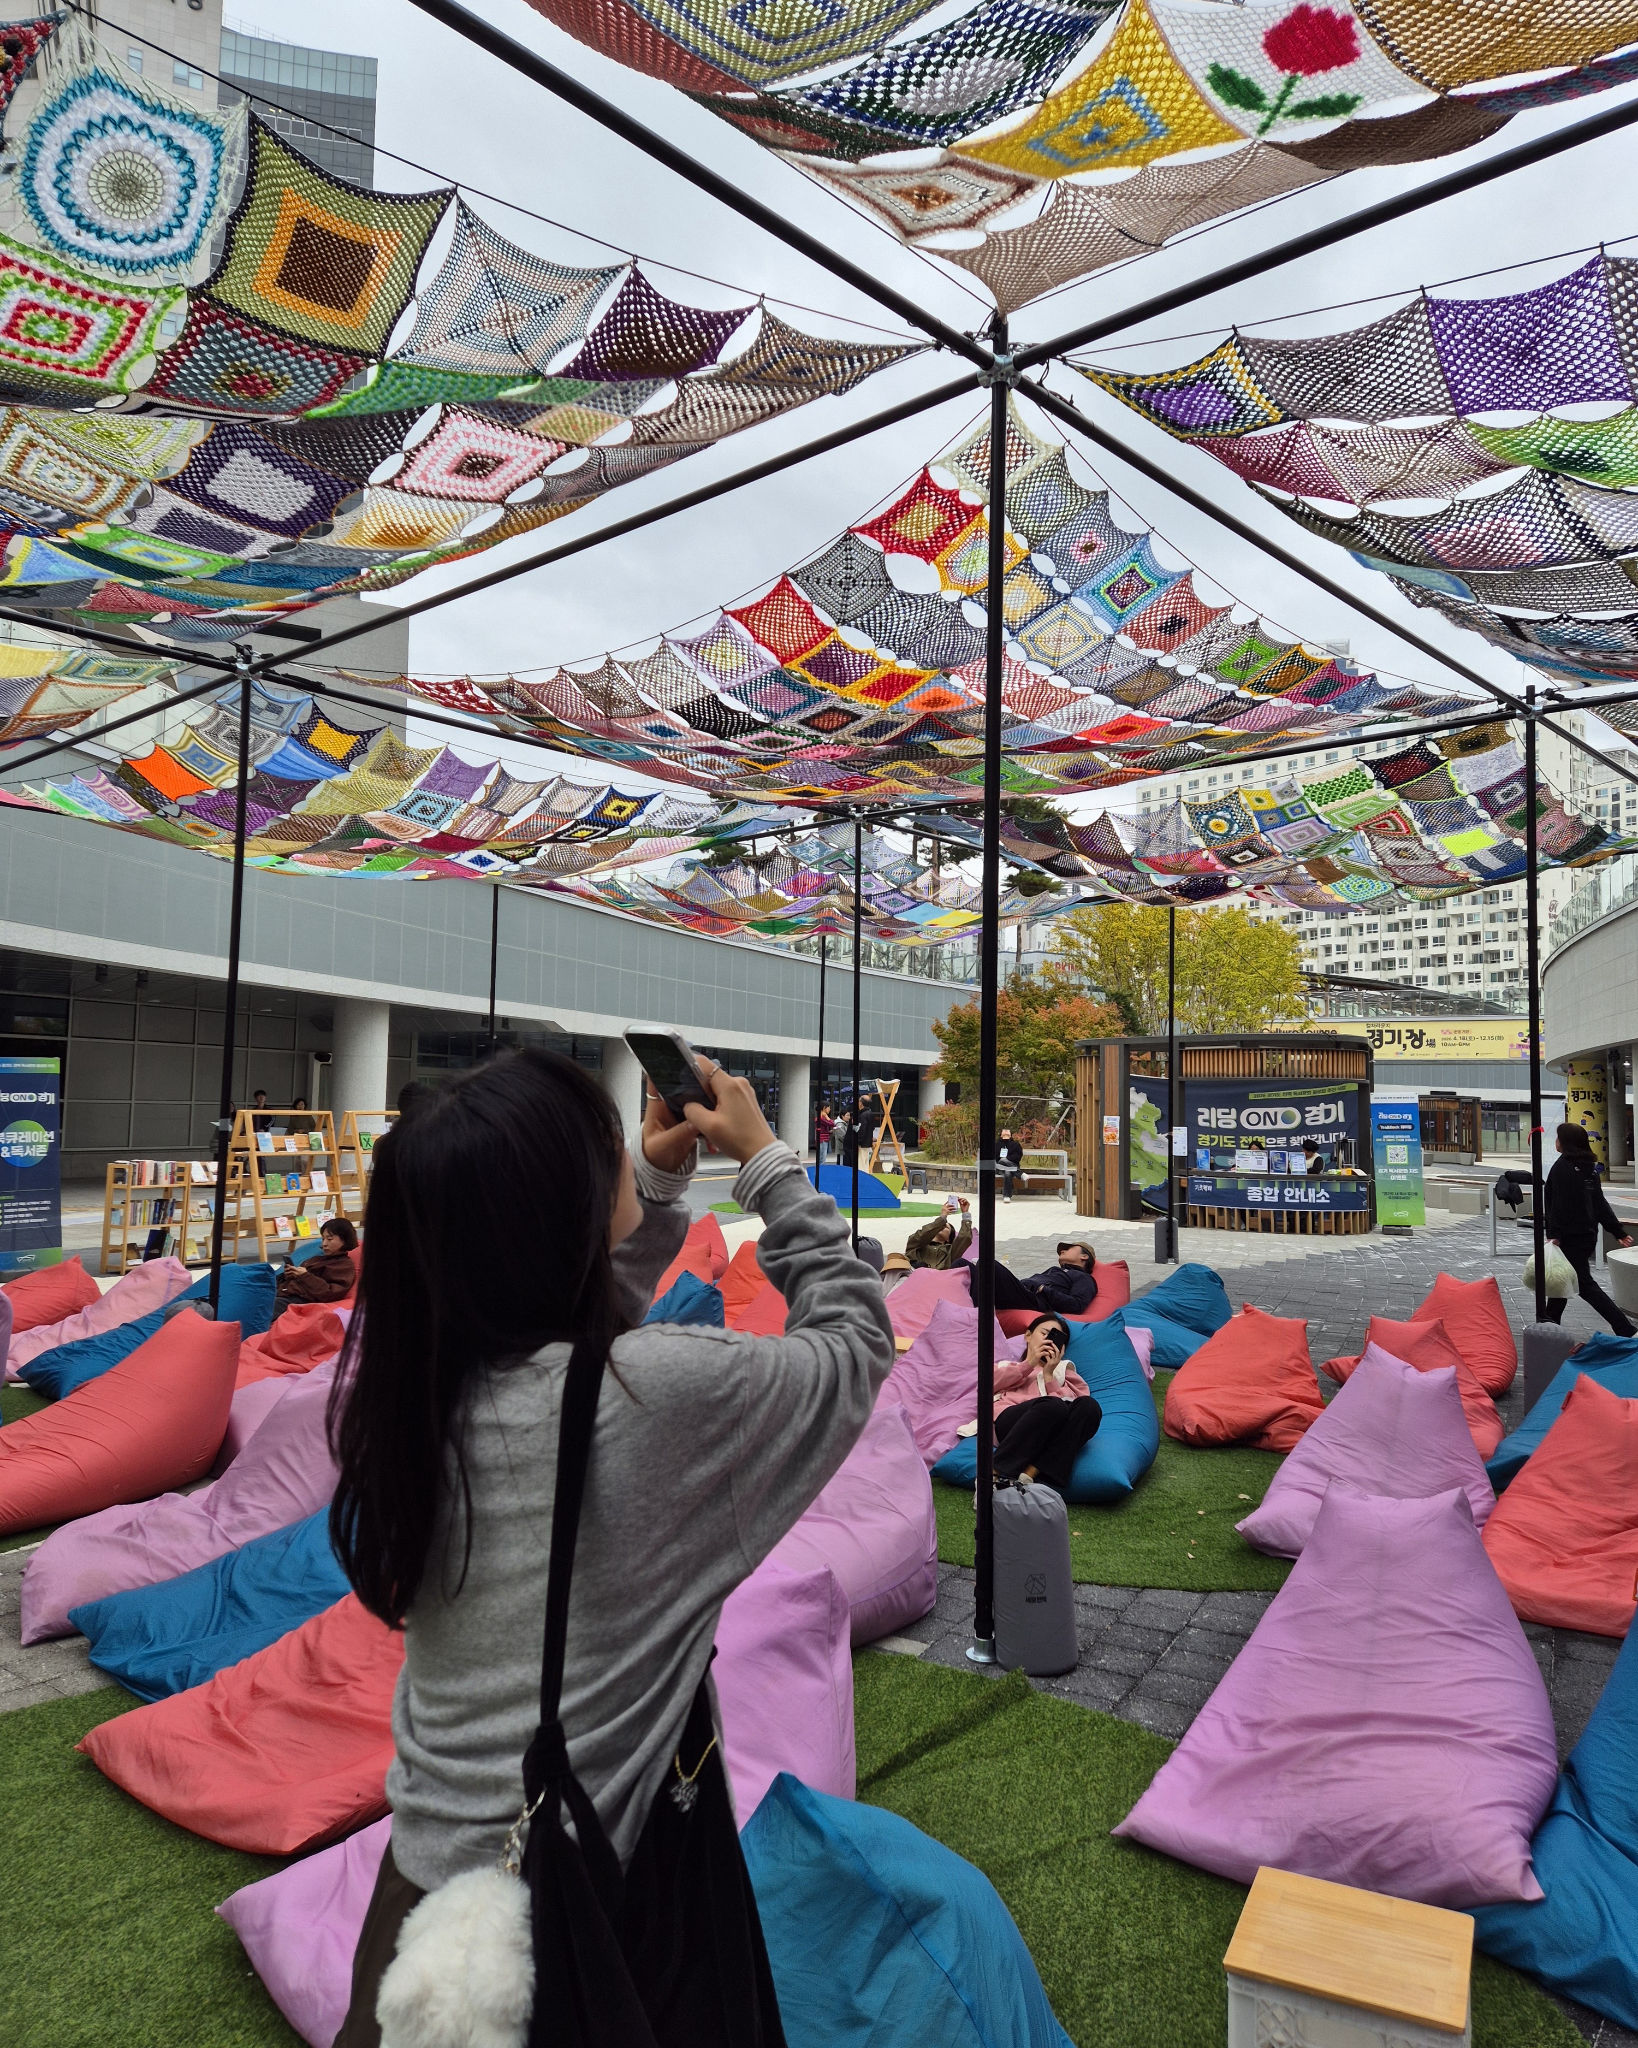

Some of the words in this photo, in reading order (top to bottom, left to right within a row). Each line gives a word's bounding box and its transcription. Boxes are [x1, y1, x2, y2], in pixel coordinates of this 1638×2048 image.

[1197, 1107, 1237, 1129] 리딩
[1305, 1100, 1345, 1126] 경기
[1197, 1134, 1236, 1147] 경기도
[1247, 1186, 1280, 1202] 종합
[1283, 1187, 1331, 1204] 안내소
